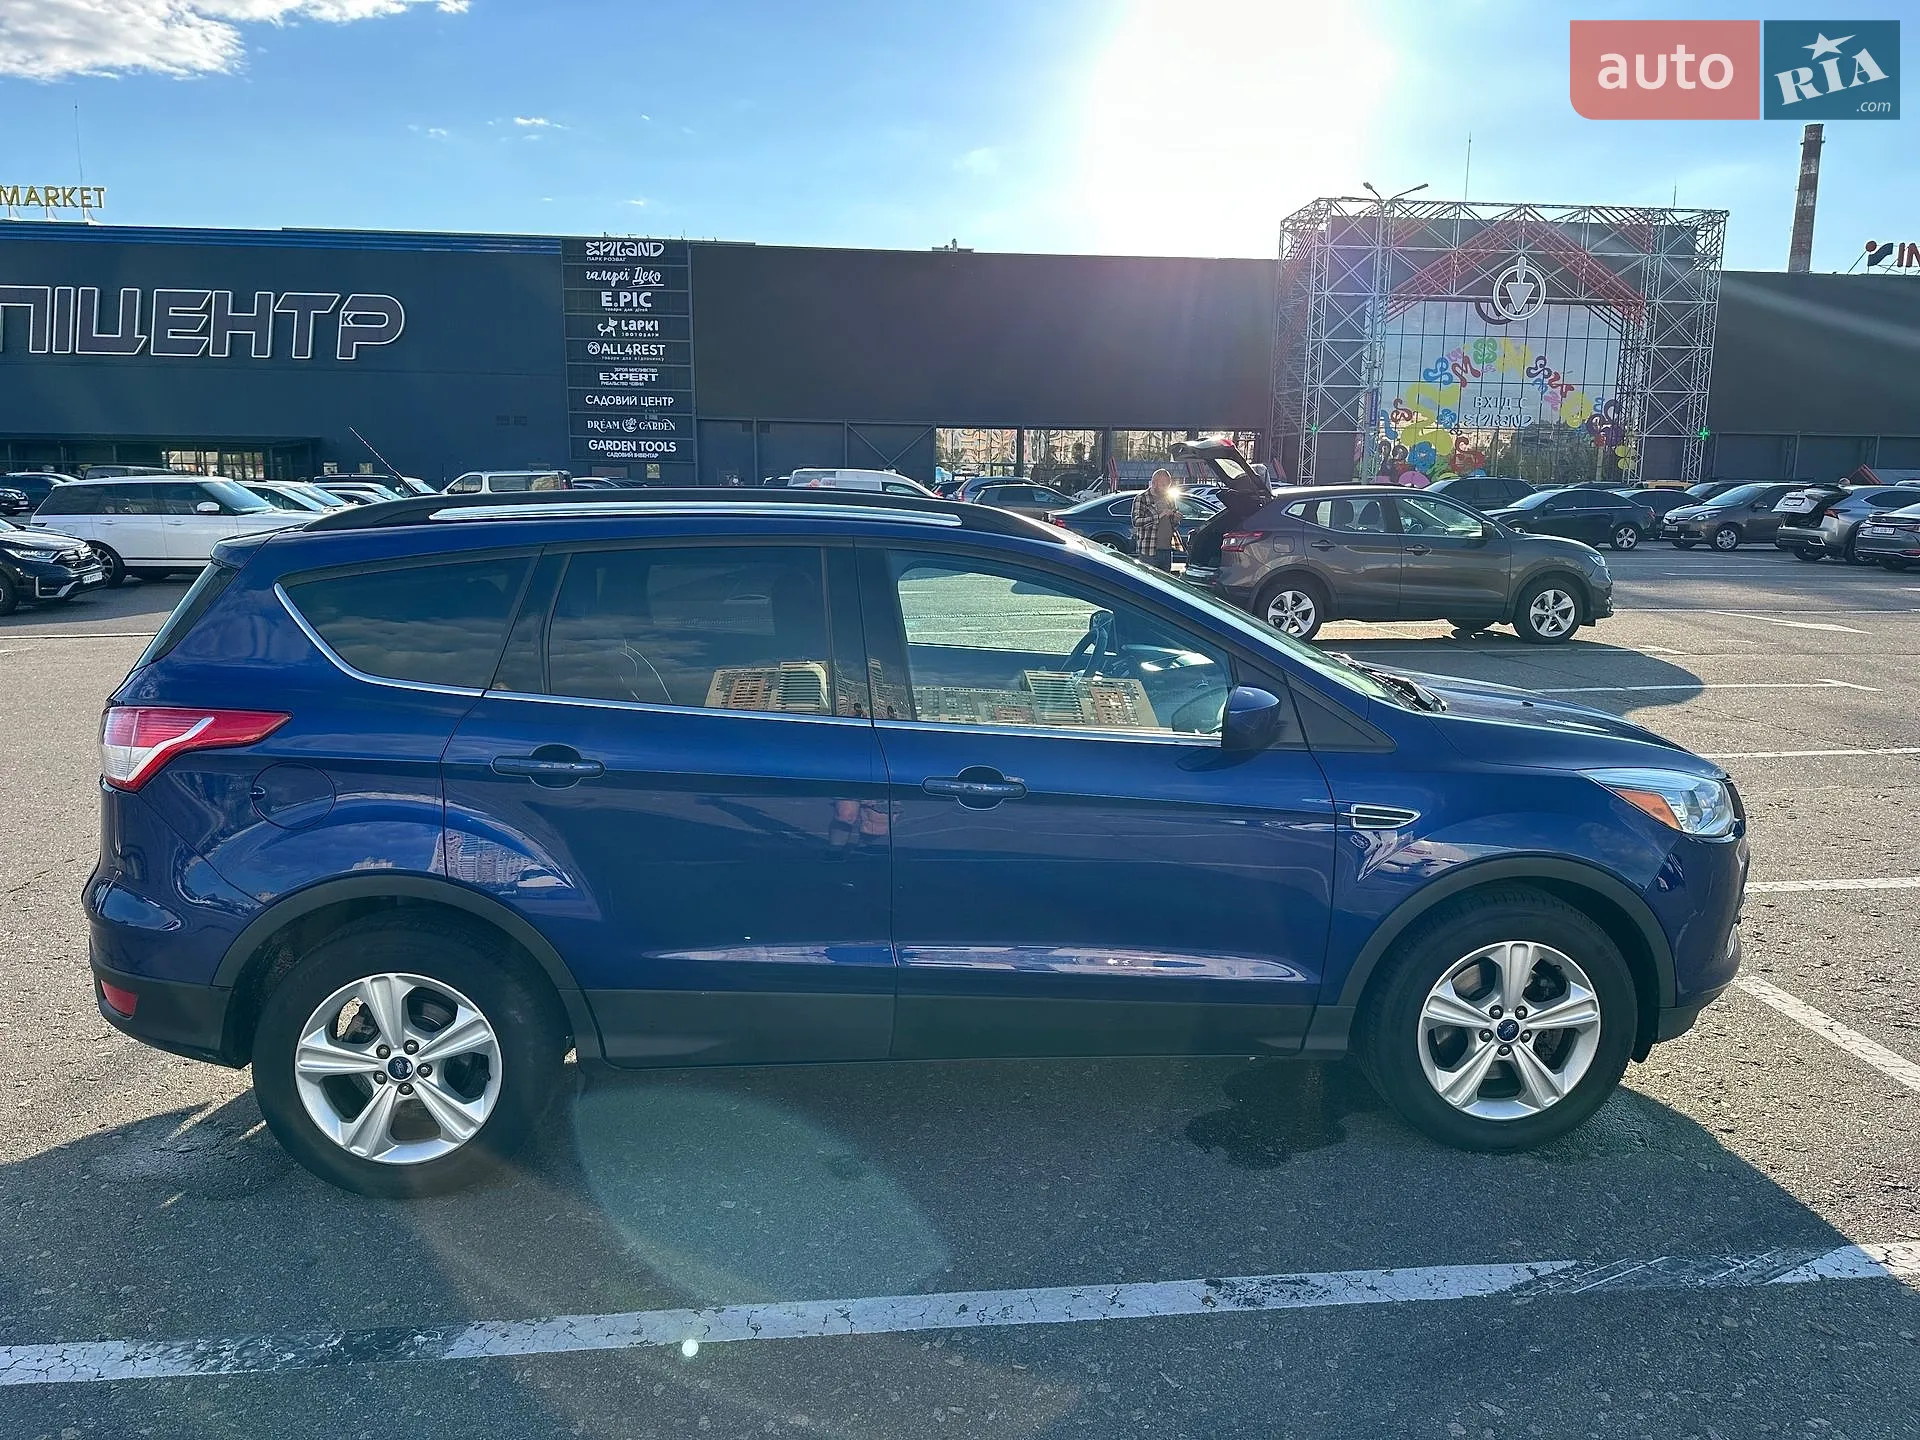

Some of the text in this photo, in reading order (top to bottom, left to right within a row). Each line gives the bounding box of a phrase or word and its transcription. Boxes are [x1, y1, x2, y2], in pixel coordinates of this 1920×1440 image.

[0, 185, 105, 208] MARKET
[601, 291, 652, 308] E.PIC
[601, 342, 666, 356] ALL4REST
[599, 372, 659, 382] EXPERT
[585, 395, 674, 407] САДОВИЙ ЦЕНТР
[638, 418, 676, 431] GARDEN
[588, 439, 677, 452] GARDEN TOOLS
